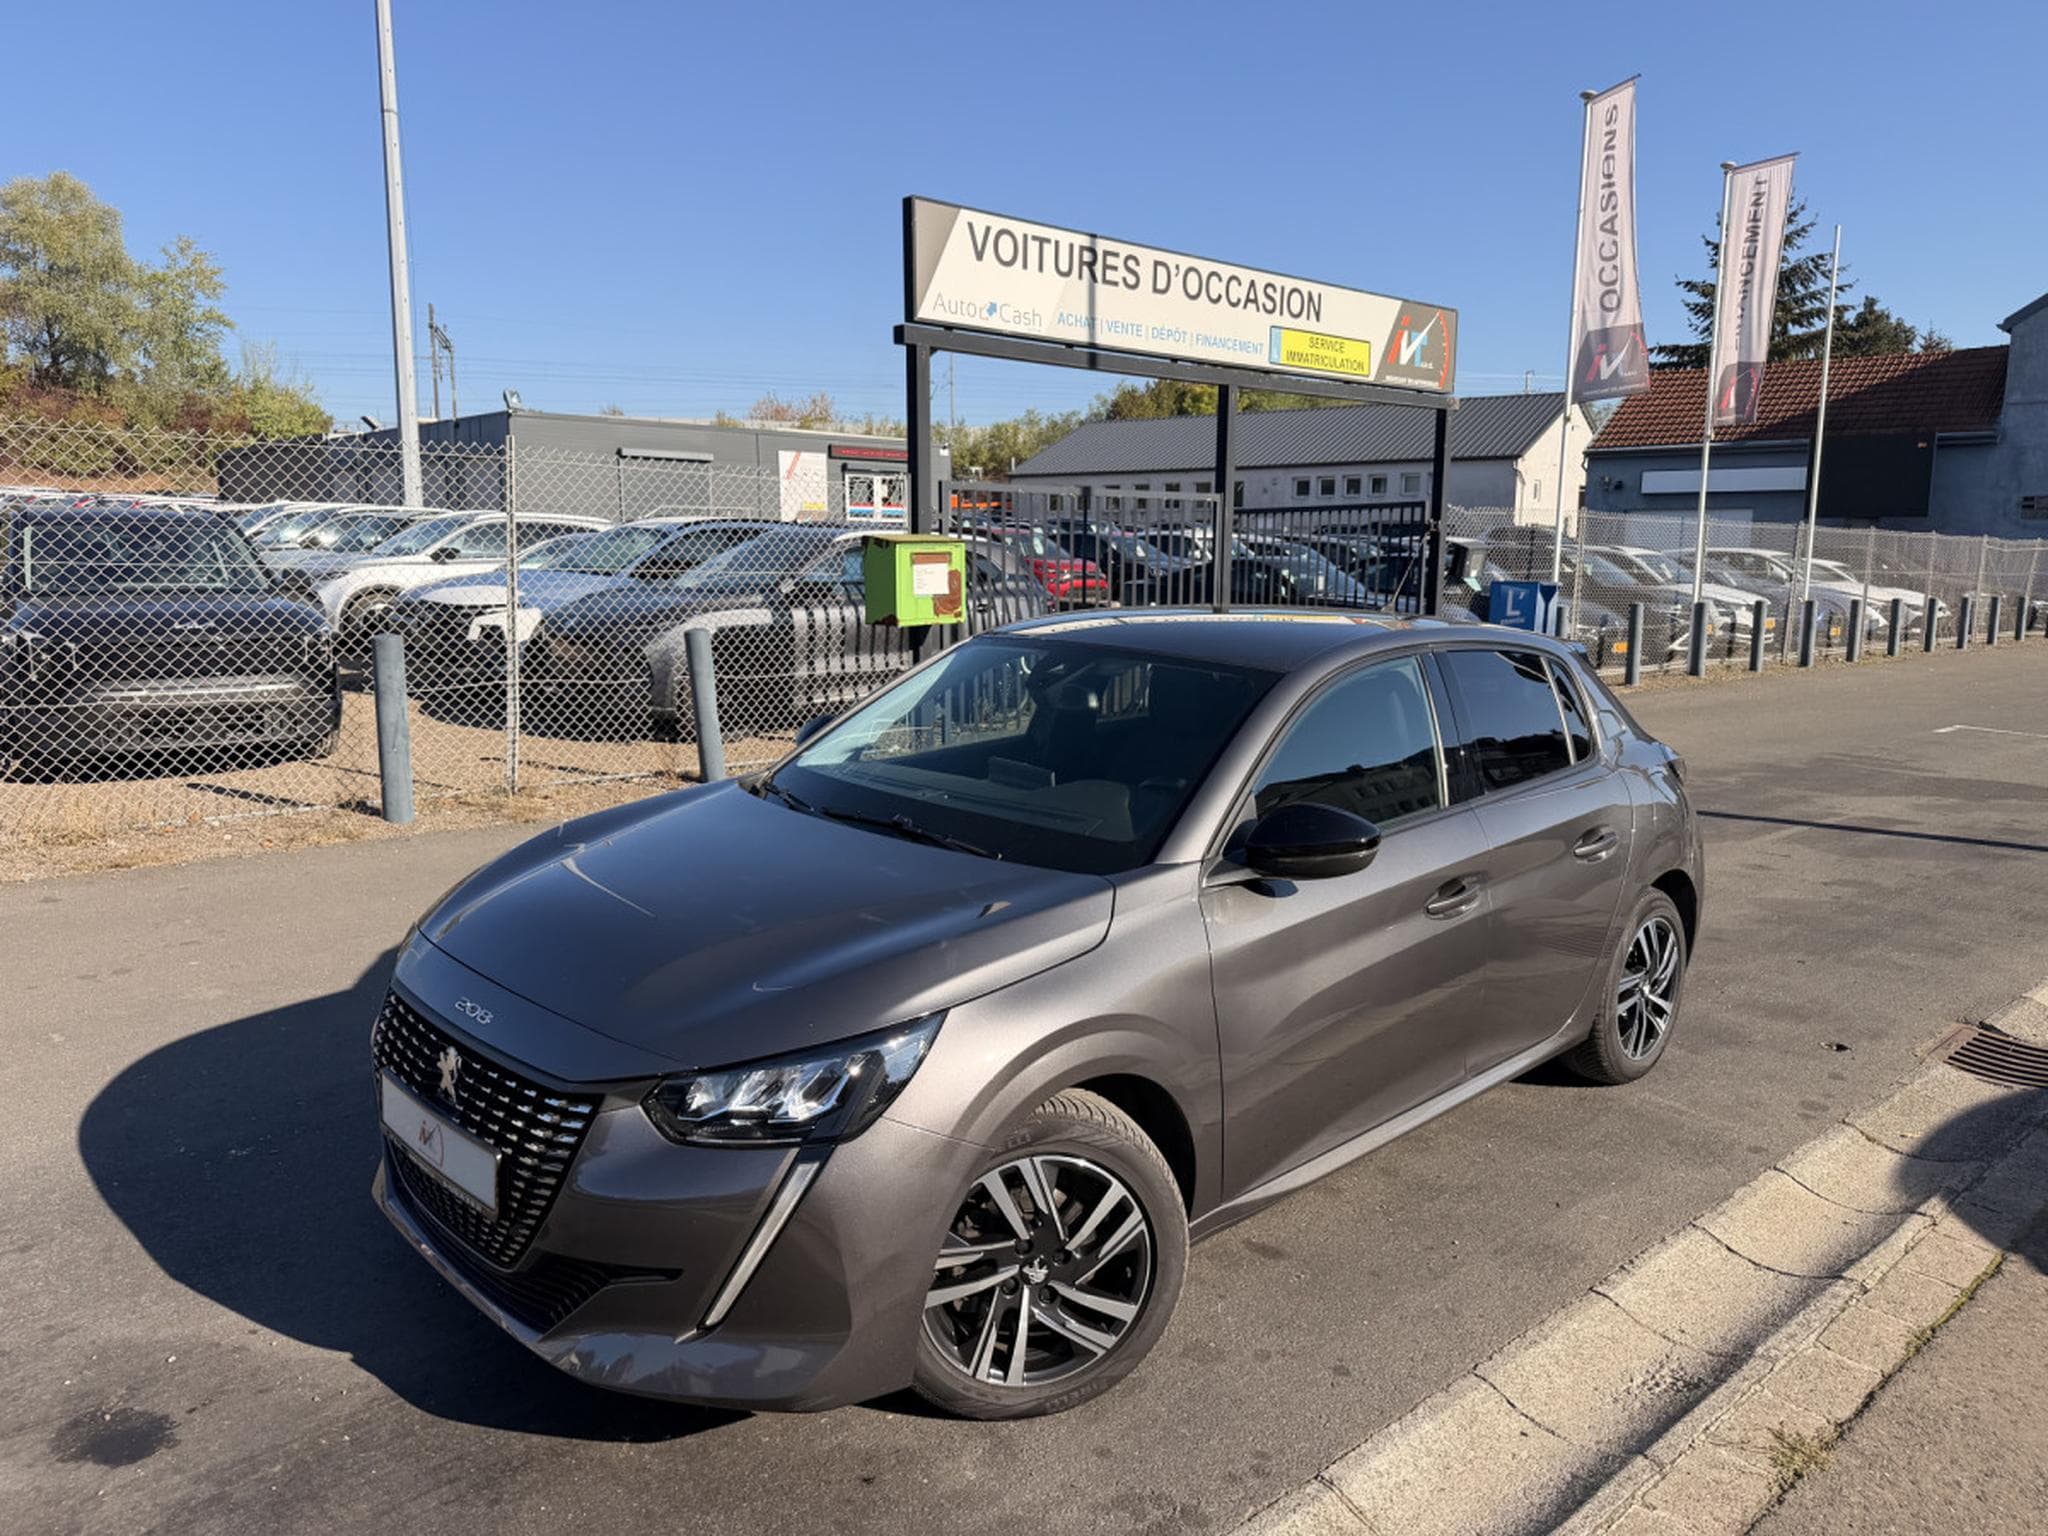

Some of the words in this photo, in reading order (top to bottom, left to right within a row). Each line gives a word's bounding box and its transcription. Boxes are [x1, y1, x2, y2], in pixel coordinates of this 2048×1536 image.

[1599, 103, 1620, 314] OCCASIONS
[967, 221, 1141, 290] VOITURES
[1152, 259, 1322, 322] D'OCCASION
[1000, 303, 1042, 327] Cash
[1057, 311, 1096, 330] ACHAT
[1107, 319, 1143, 337] VENTE
[1151, 323, 1188, 343] DÉPÔT
[1196, 333, 1264, 356] FINANCEMENT
[1308, 335, 1346, 354] SERVICE
[1286, 349, 1365, 373] IMMATRICULATION
[455, 996, 494, 1024] 208
